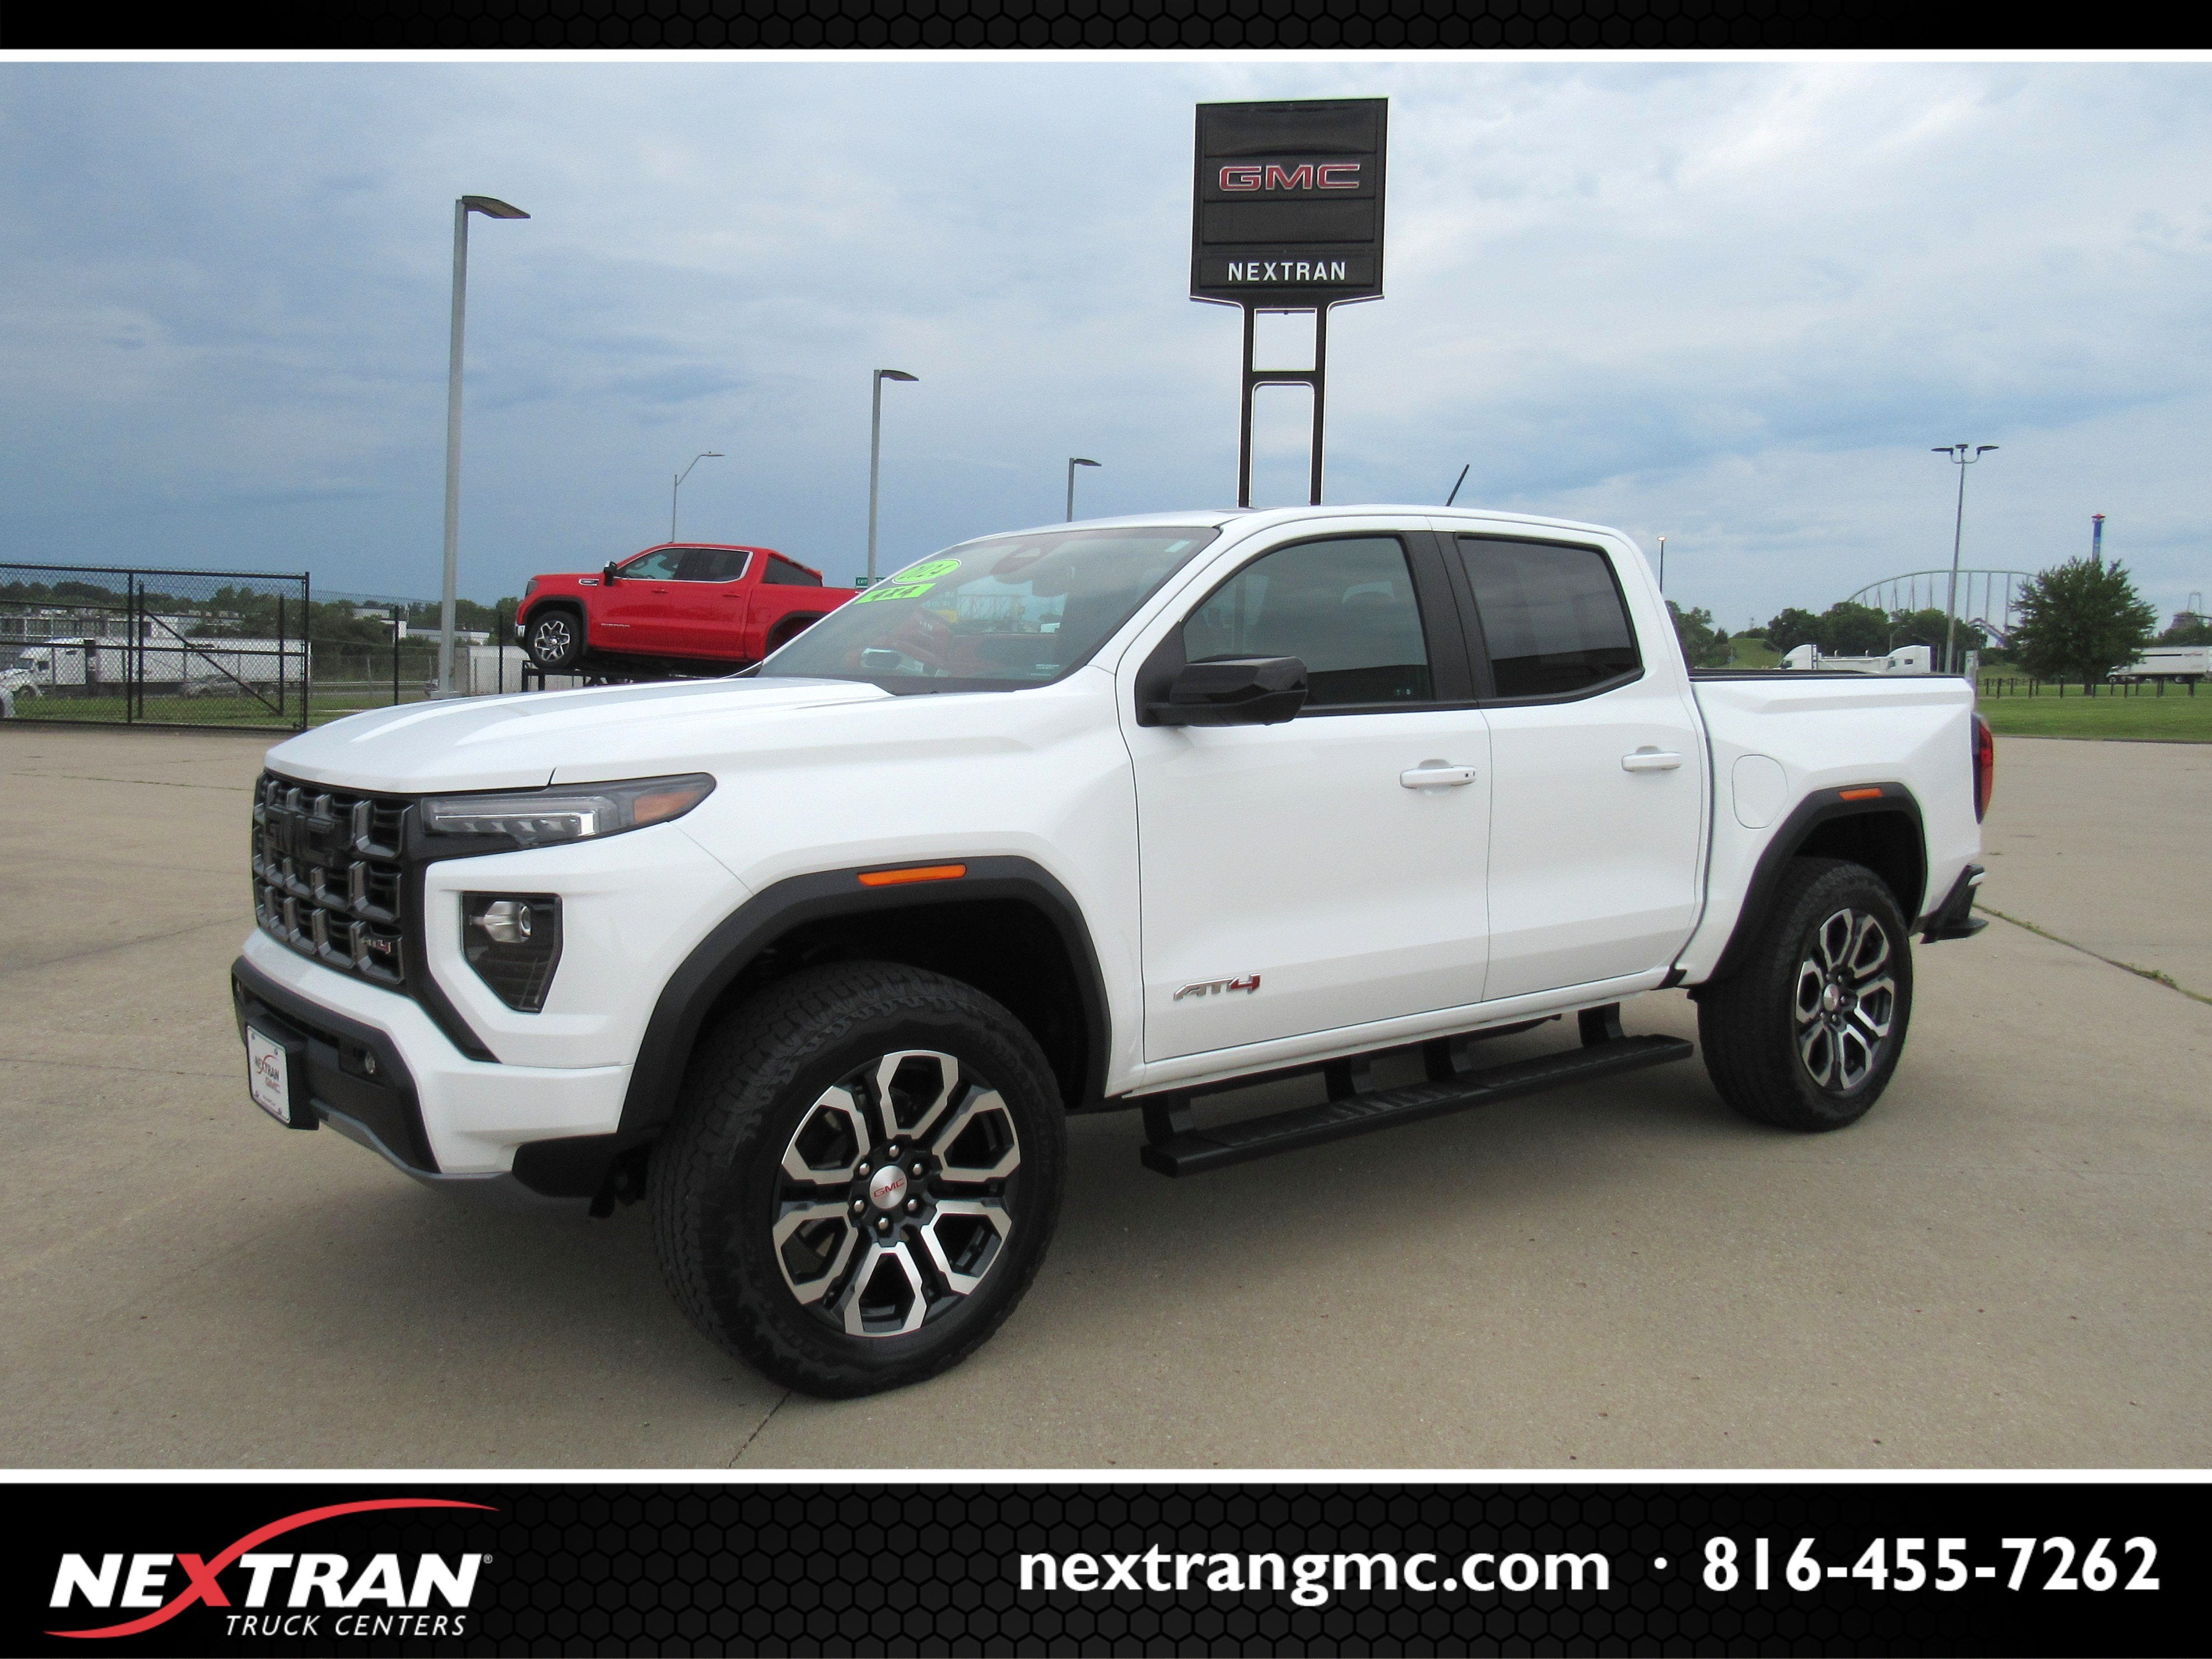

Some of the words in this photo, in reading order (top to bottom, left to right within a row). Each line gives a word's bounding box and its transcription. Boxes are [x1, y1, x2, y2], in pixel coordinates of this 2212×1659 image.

[1219, 164, 1360, 191] GMC
[1228, 262, 1345, 281] NEXTRAN
[264, 804, 334, 866] GMC
[1173, 973, 1261, 1001] AT4
[874, 1178, 905, 1197] GMC
